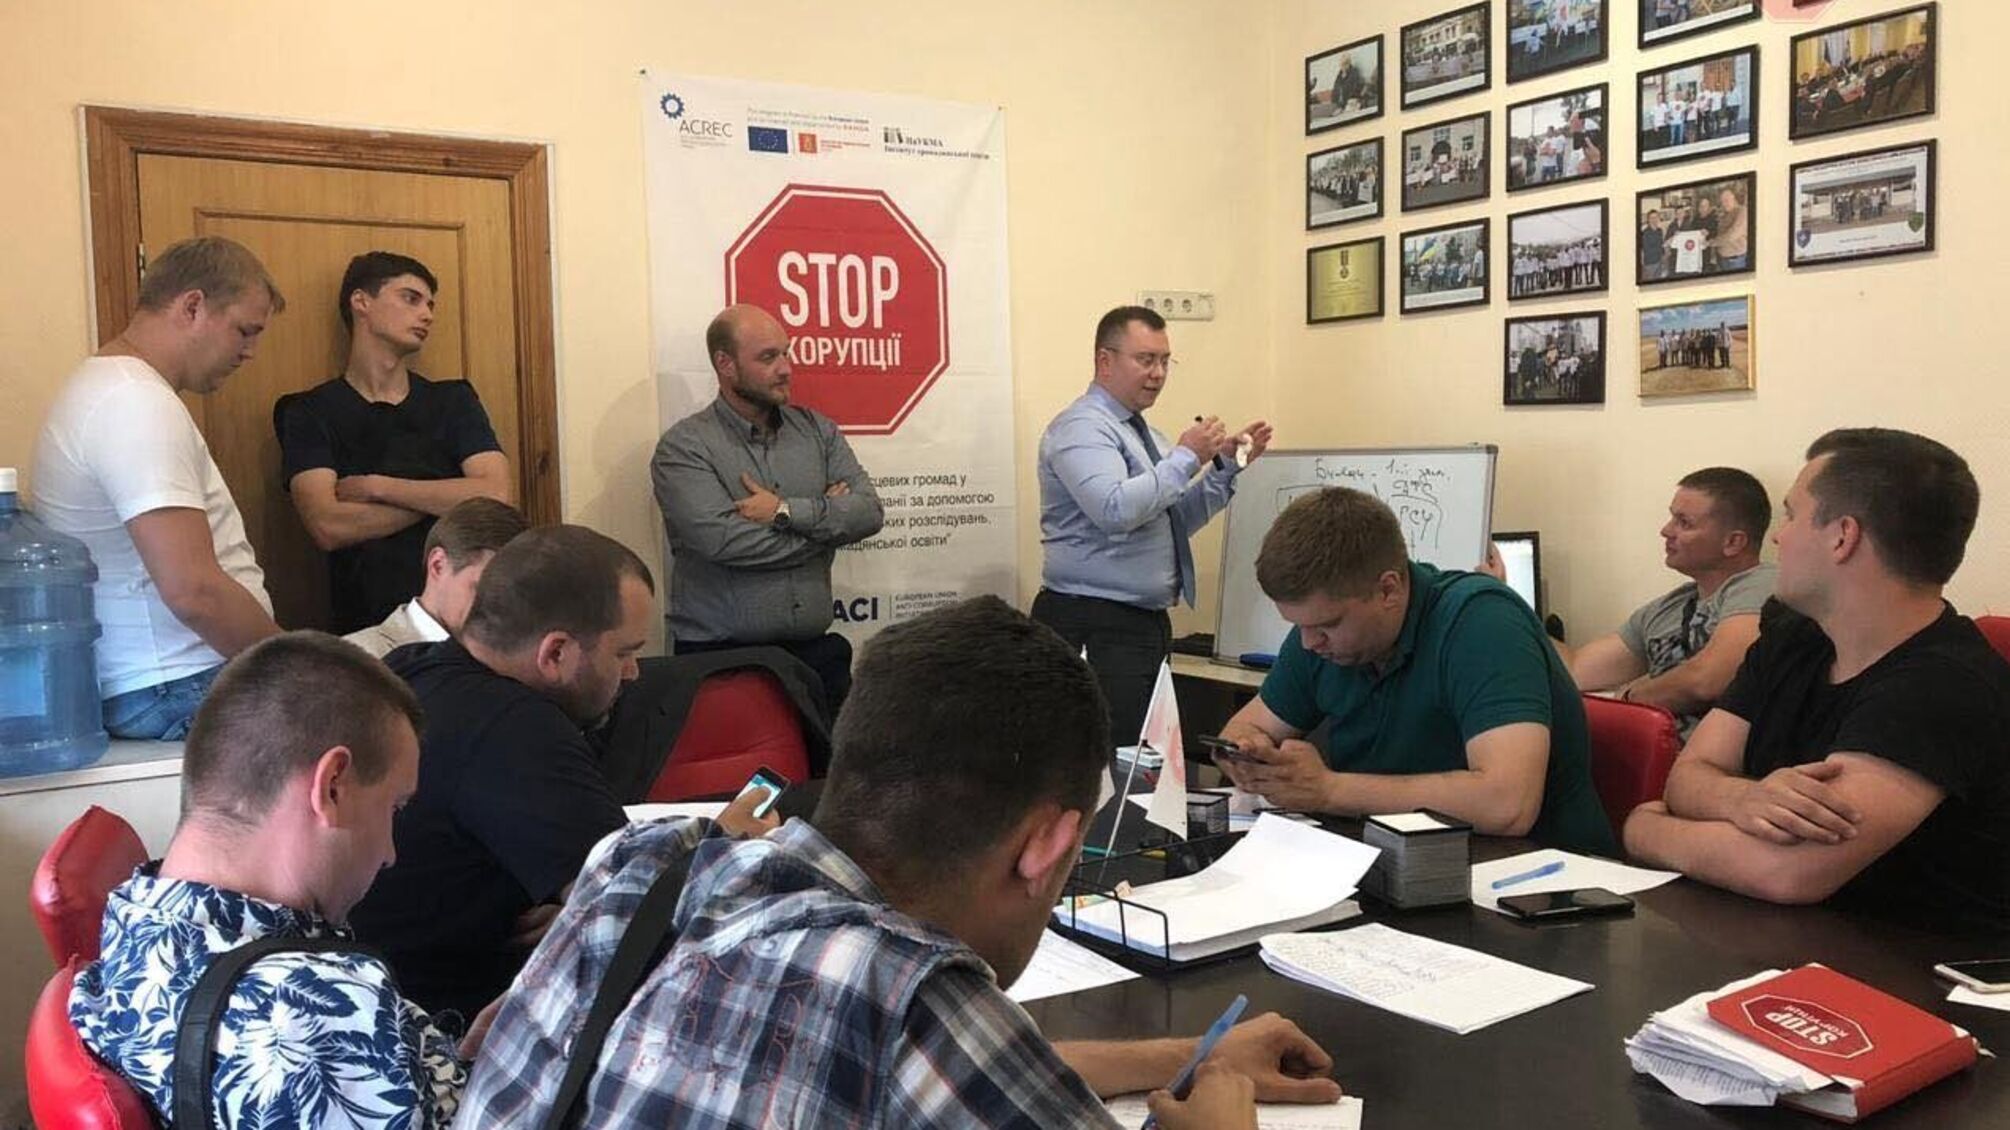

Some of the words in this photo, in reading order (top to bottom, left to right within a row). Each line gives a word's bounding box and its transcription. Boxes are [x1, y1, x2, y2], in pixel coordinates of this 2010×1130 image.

[679, 119, 733, 138] ACREC
[777, 250, 900, 329] STOP
[913, 474, 958, 488] громад
[960, 474, 967, 487] у
[910, 495, 924, 507] за
[927, 493, 995, 507] допомогою
[833, 597, 878, 622] ACI
[1765, 1011, 1838, 1046] STOP
